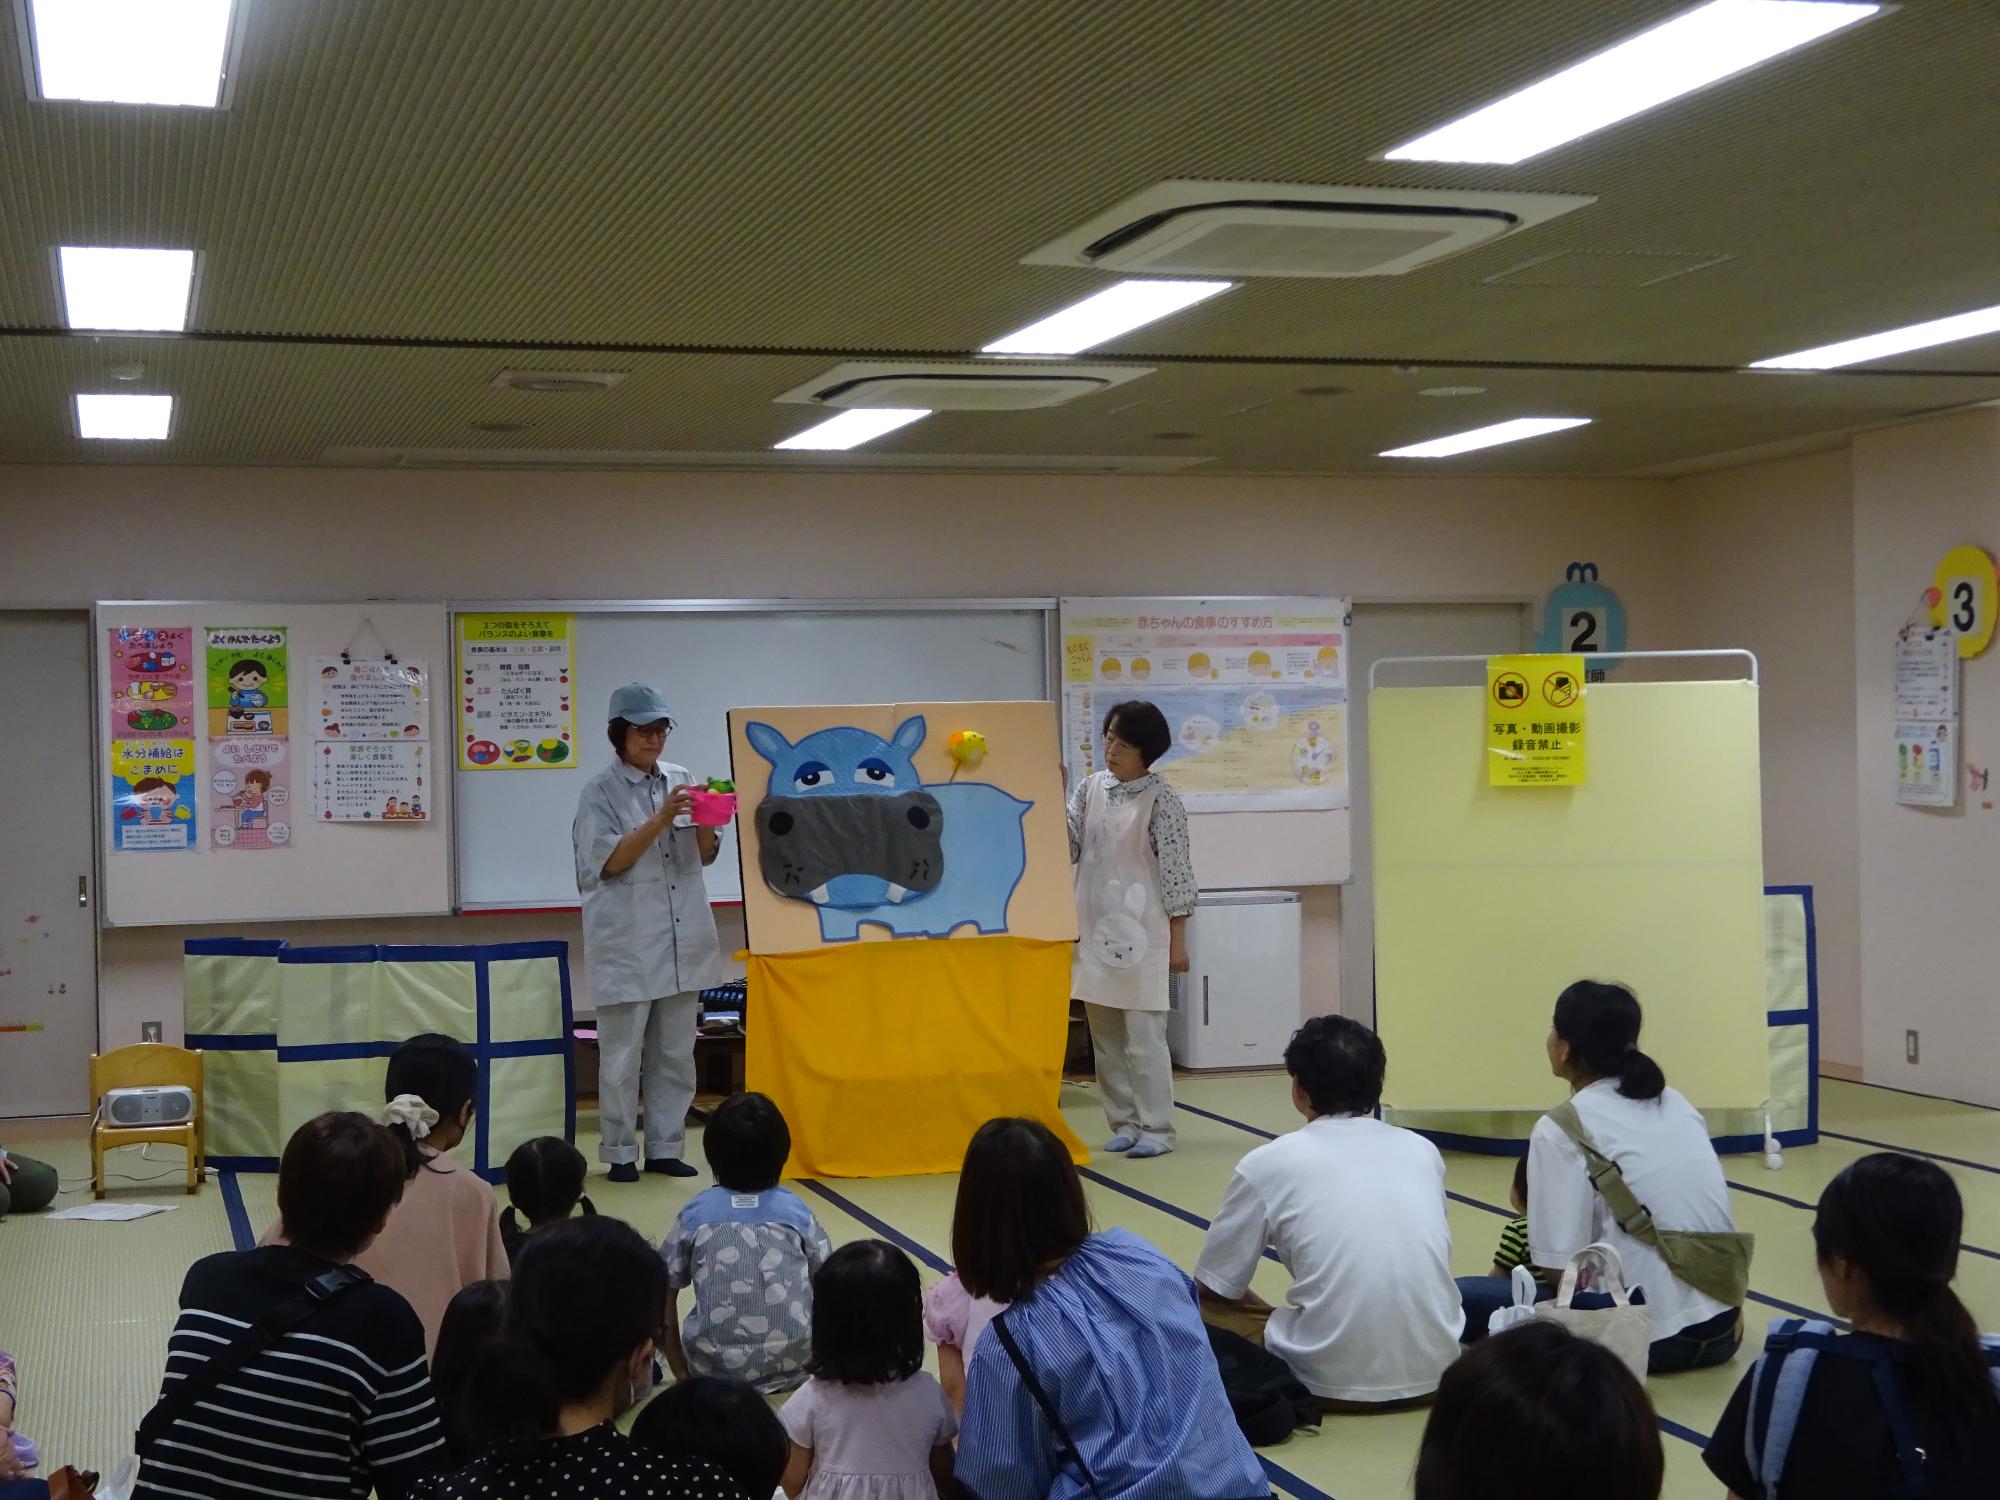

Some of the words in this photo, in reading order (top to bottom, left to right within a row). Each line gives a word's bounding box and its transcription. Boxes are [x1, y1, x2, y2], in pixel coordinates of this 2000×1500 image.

[1953, 582, 1974, 632] 3
[1137, 616, 1273, 630] 赤ちゃんの食事のすすめ方
[1570, 611, 1598, 652] 2
[1493, 722, 1581, 735] 写真・動画撮影
[1512, 739, 1562, 751] 録音禁止
[122, 748, 184, 759] 水分補給は
[130, 765, 178, 775] こまめに
